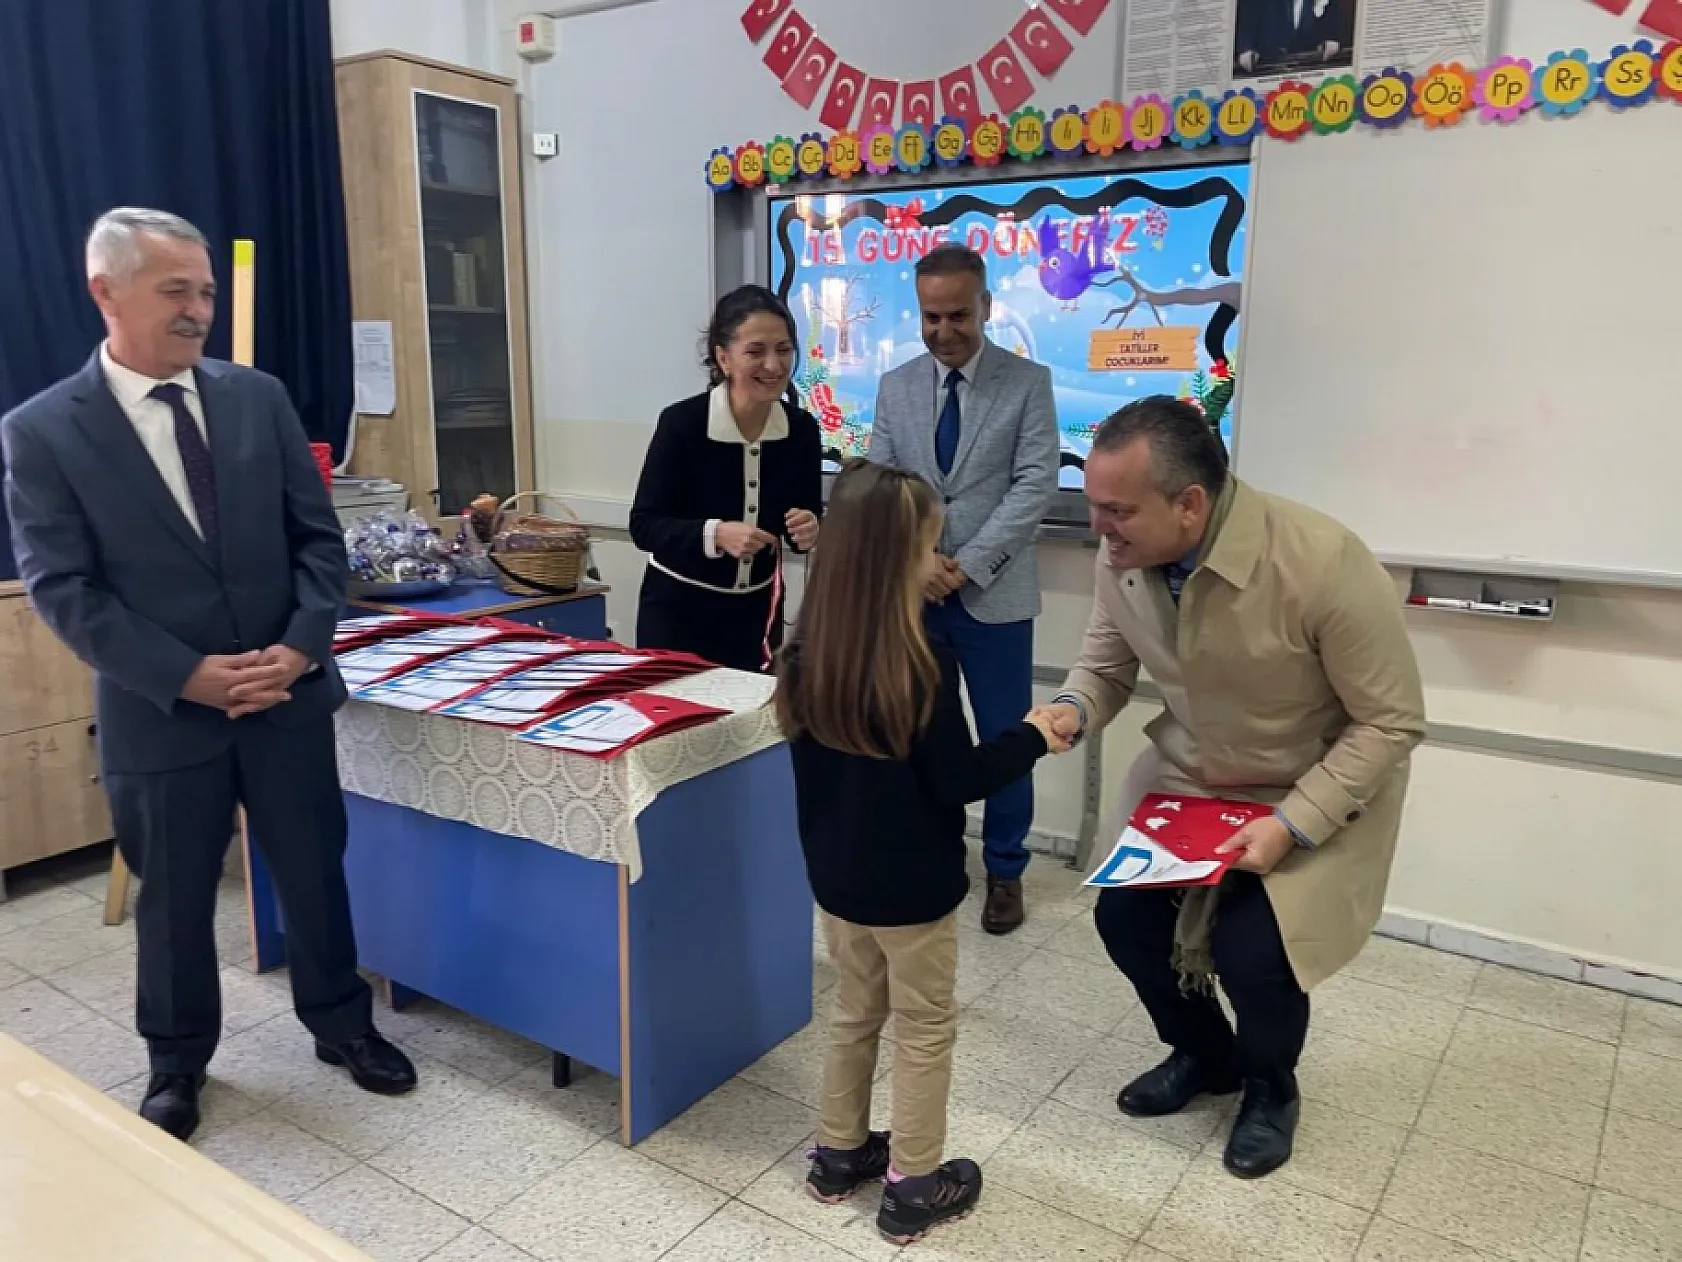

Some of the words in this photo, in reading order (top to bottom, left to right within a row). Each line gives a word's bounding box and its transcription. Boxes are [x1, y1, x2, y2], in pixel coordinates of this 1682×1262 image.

[711, 159, 730, 176] Aa
[743, 153, 760, 172] Bb
[772, 146, 791, 167] Cc
[835, 143, 855, 163] Dd
[873, 137, 892, 157] Ee
[904, 135, 919, 161] Ff
[1015, 122, 1041, 143] Hh
[1138, 107, 1153, 137] Jj
[1181, 105, 1206, 129] Kk
[1227, 102, 1247, 126] Ll
[1271, 98, 1305, 121] Mm
[1317, 91, 1349, 115] Nn
[1366, 84, 1404, 108] Oo
[1423, 76, 1463, 106] Öö
[1492, 73, 1523, 106] Pp
[1554, 67, 1583, 93] Rr
[1615, 60, 1645, 84] Ss
[808, 229, 842, 265] 15
